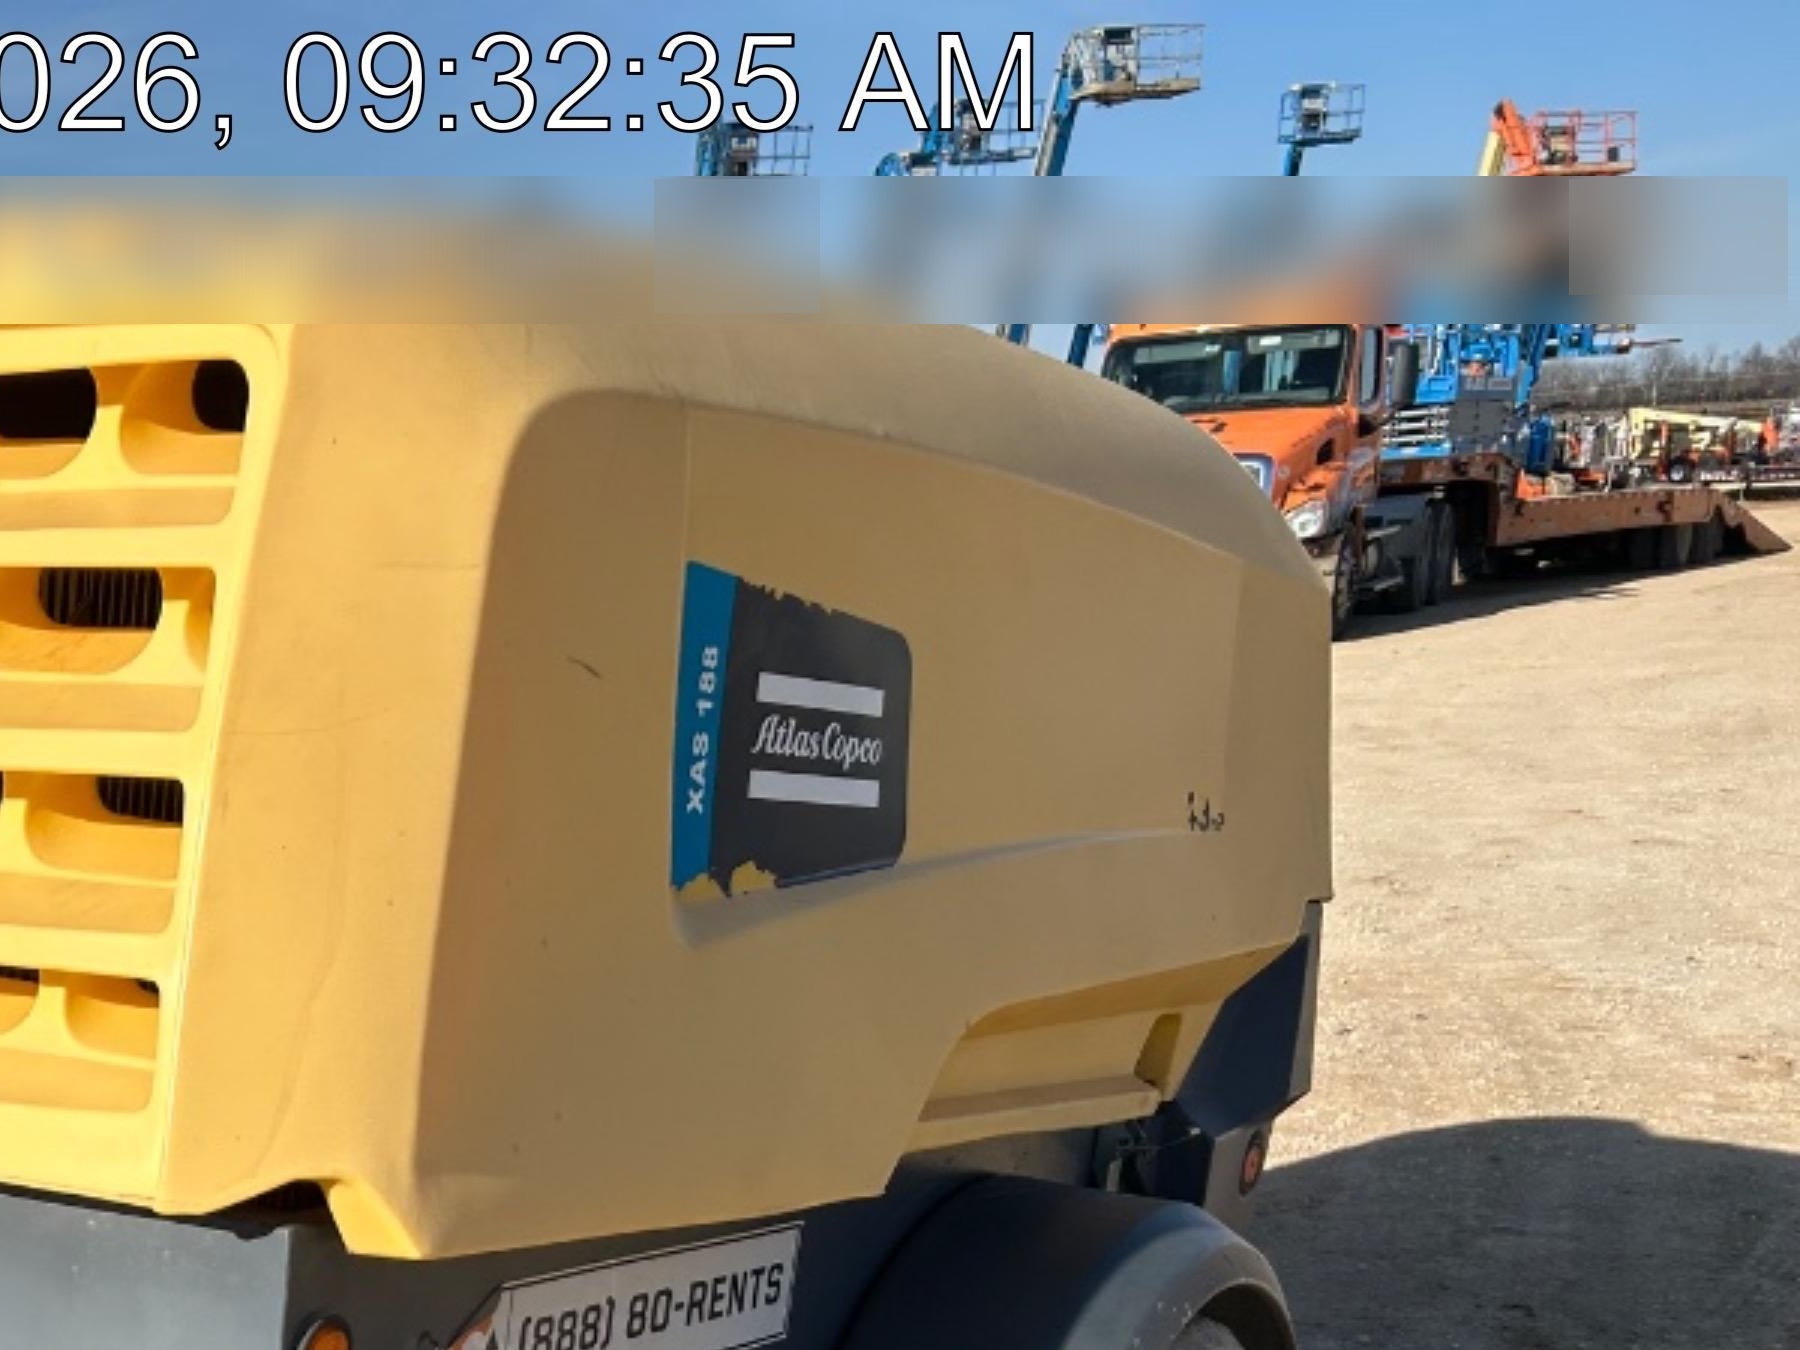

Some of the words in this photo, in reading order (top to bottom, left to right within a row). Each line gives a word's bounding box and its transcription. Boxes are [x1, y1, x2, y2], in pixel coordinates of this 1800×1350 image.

[695, 645, 720, 718] 188
[685, 730, 711, 815] XAS
[751, 712, 822, 760] Atlas
[821, 721, 883, 771] Copco
[625, 1262, 785, 1340] 80-RENTS
